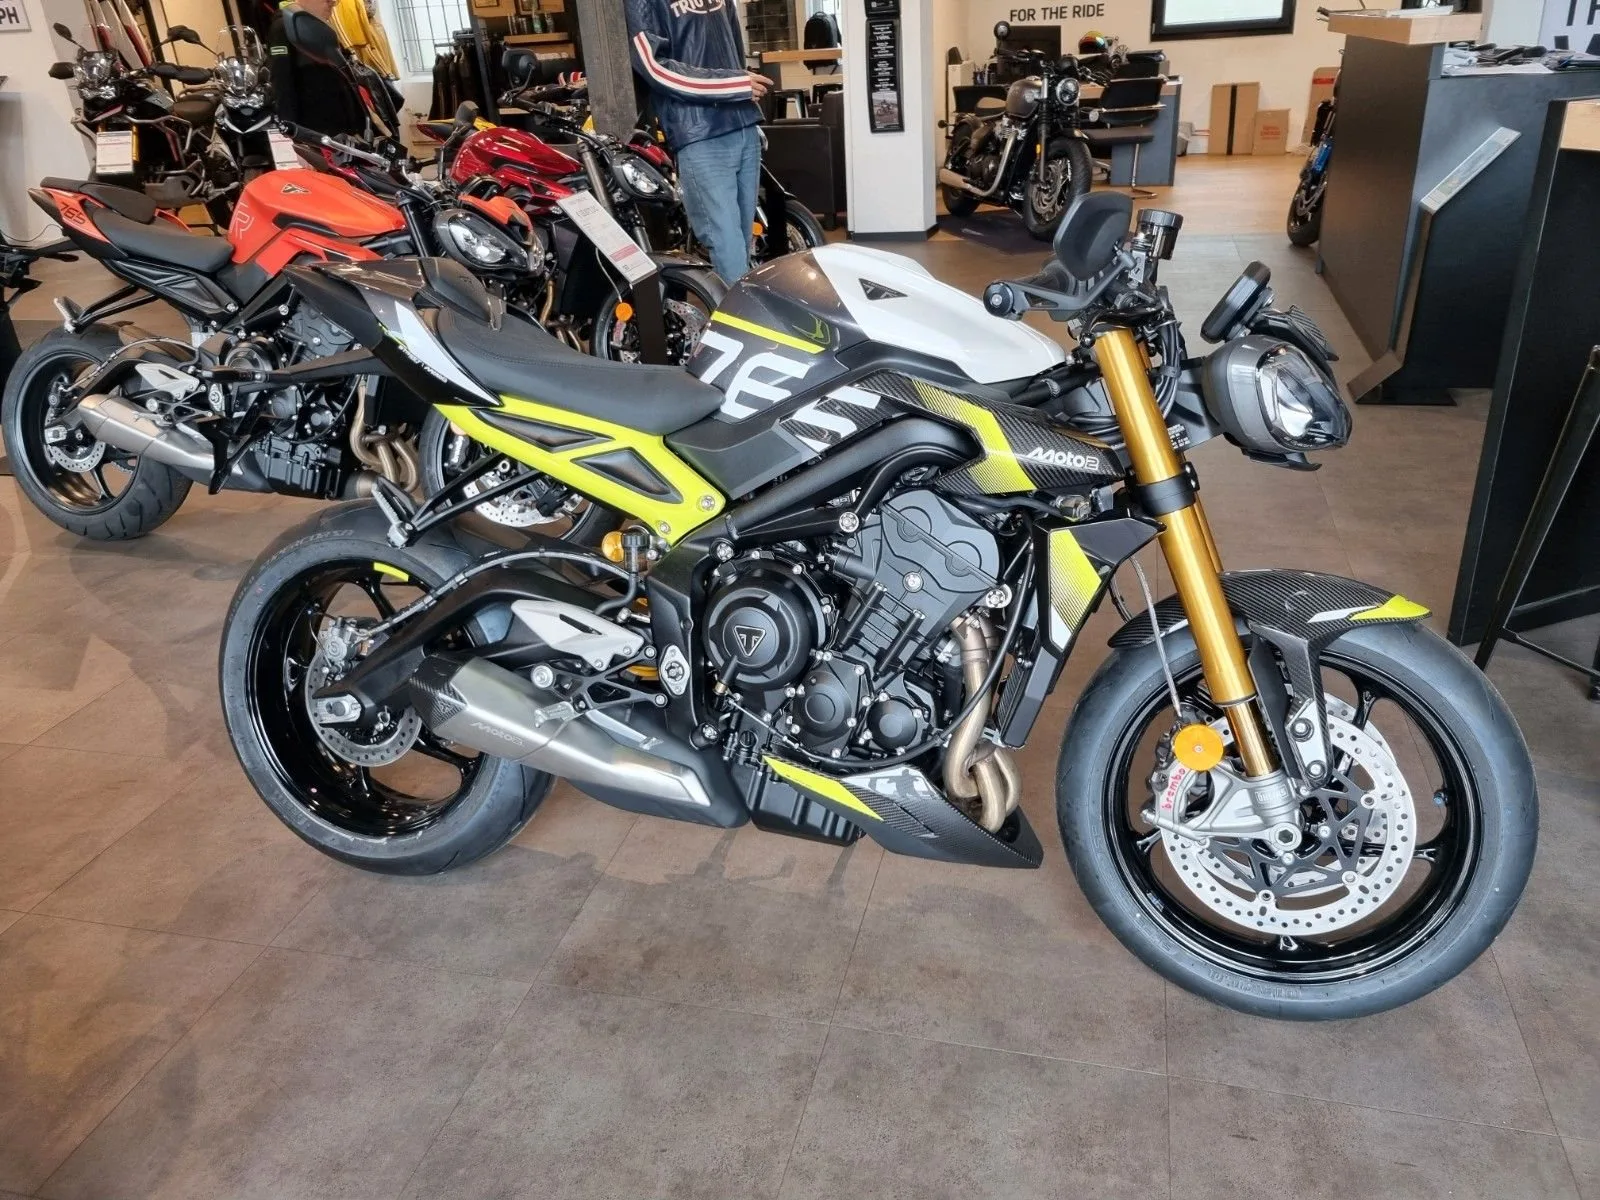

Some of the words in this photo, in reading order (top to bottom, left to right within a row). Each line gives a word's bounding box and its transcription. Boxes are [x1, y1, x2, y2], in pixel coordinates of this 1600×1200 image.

[1009, 8, 1036, 22] FOR
[1041, 6, 1068, 20] THE
[1072, 3, 1105, 18] RIDE
[60, 201, 86, 225] 765
[1161, 767, 1186, 810] brembo
